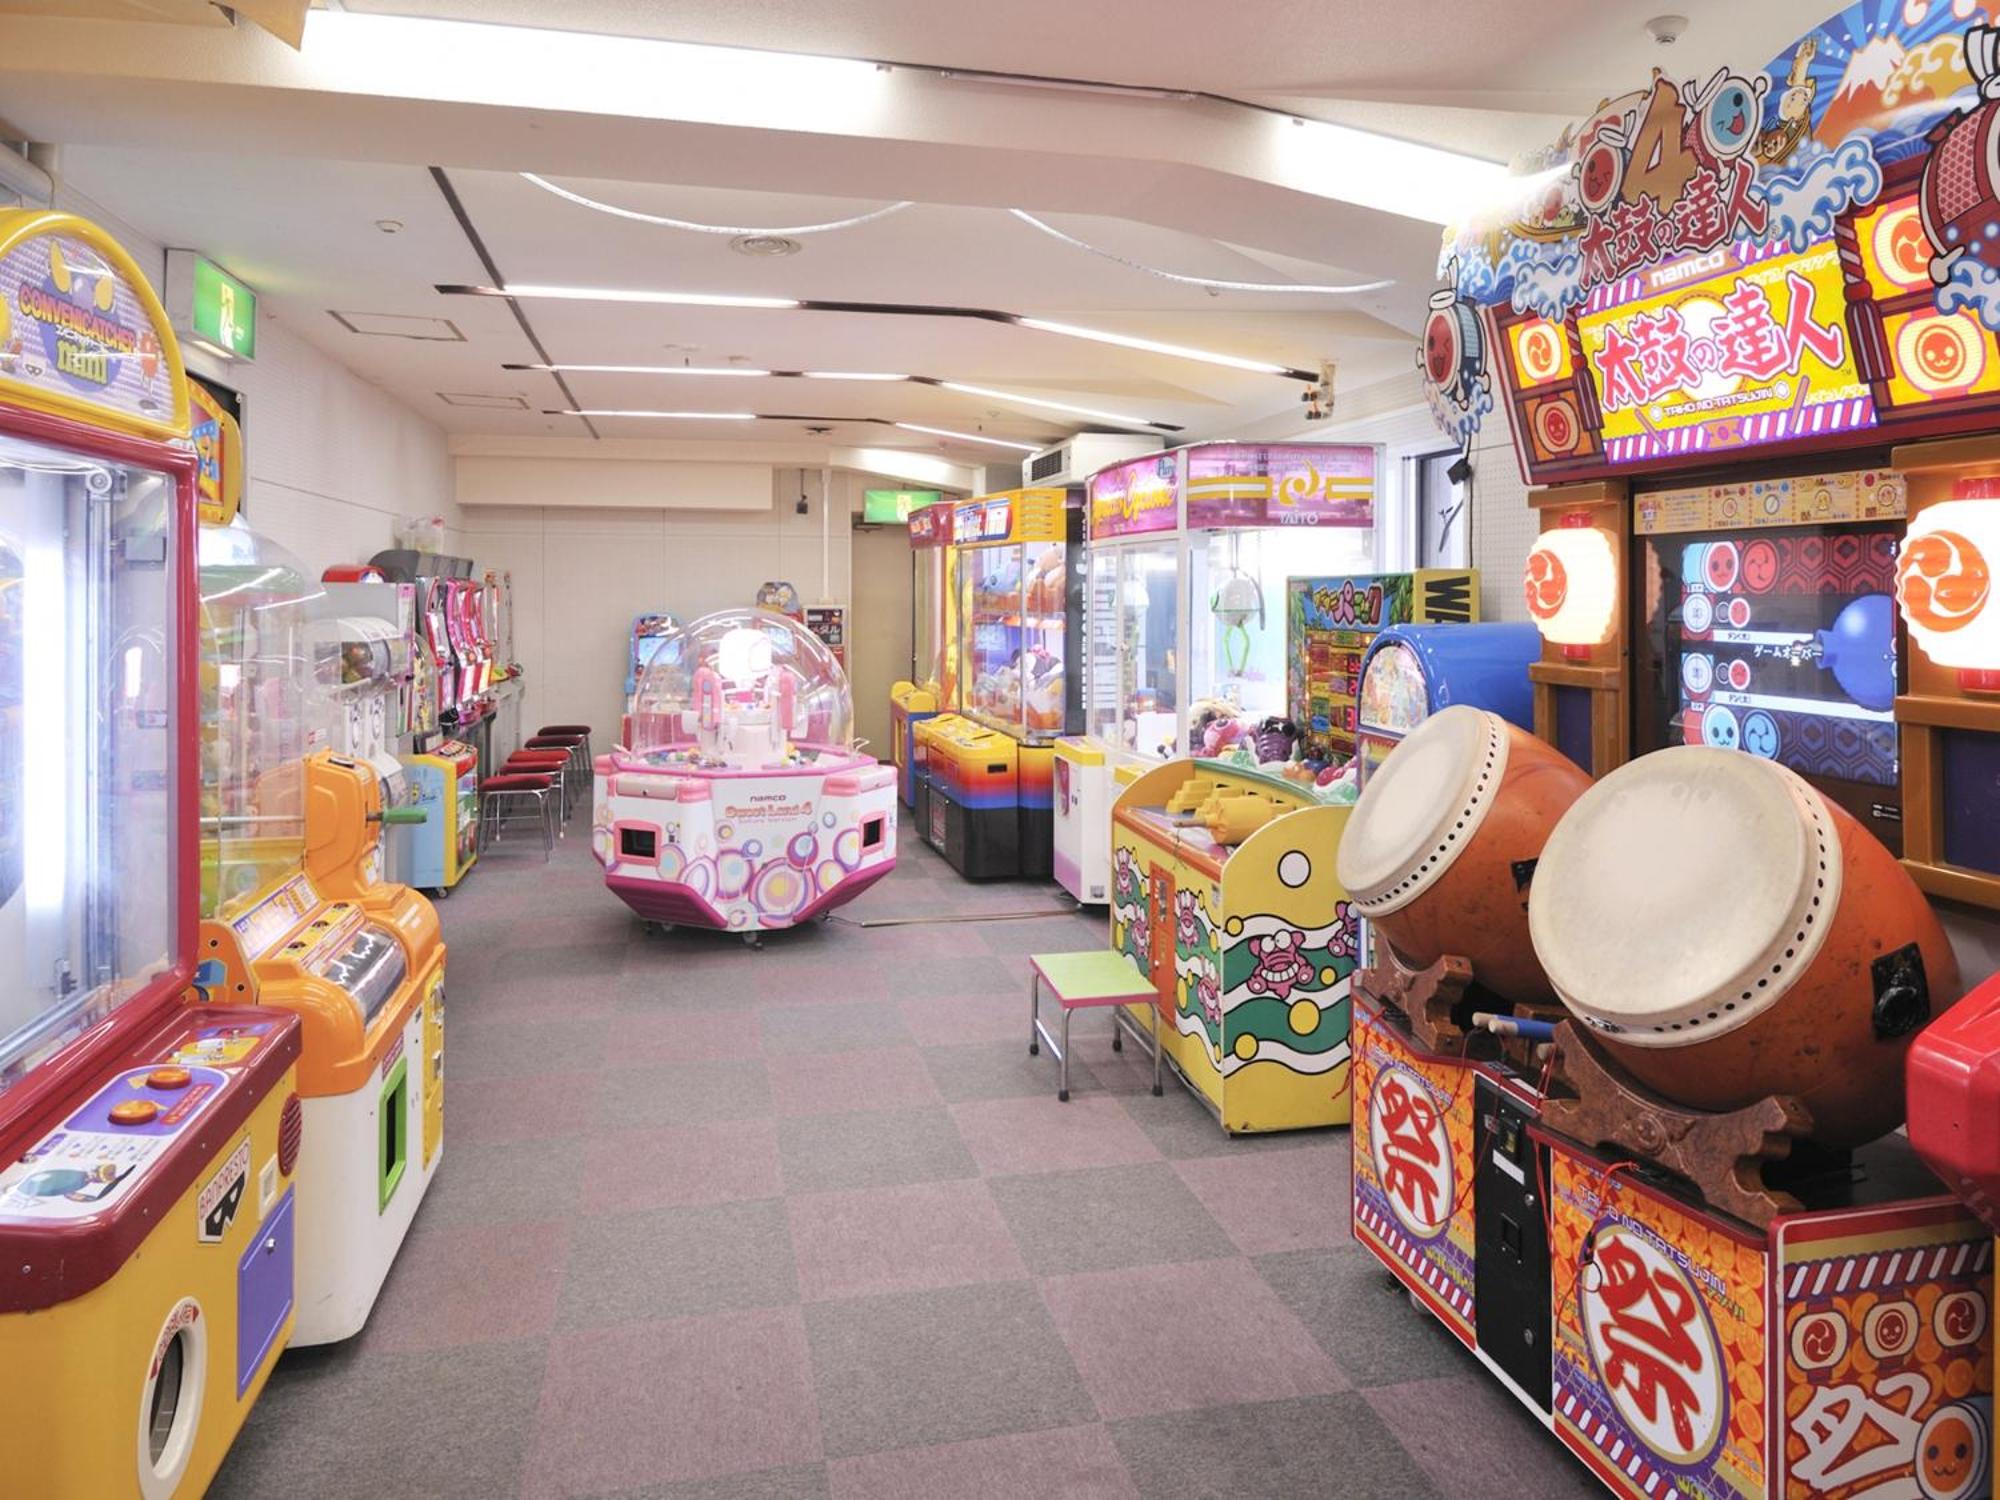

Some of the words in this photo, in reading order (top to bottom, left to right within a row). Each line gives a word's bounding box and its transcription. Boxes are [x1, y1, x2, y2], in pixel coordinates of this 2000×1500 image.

[1578, 157, 1769, 292] 太鼓の達人
[1651, 250, 1726, 289] namco
[1593, 271, 1846, 412] 太鼓の達人
[1280, 511, 1319, 526] TAITO
[749, 794, 787, 803] namco
[1579, 1183, 1619, 1222] TAIO
